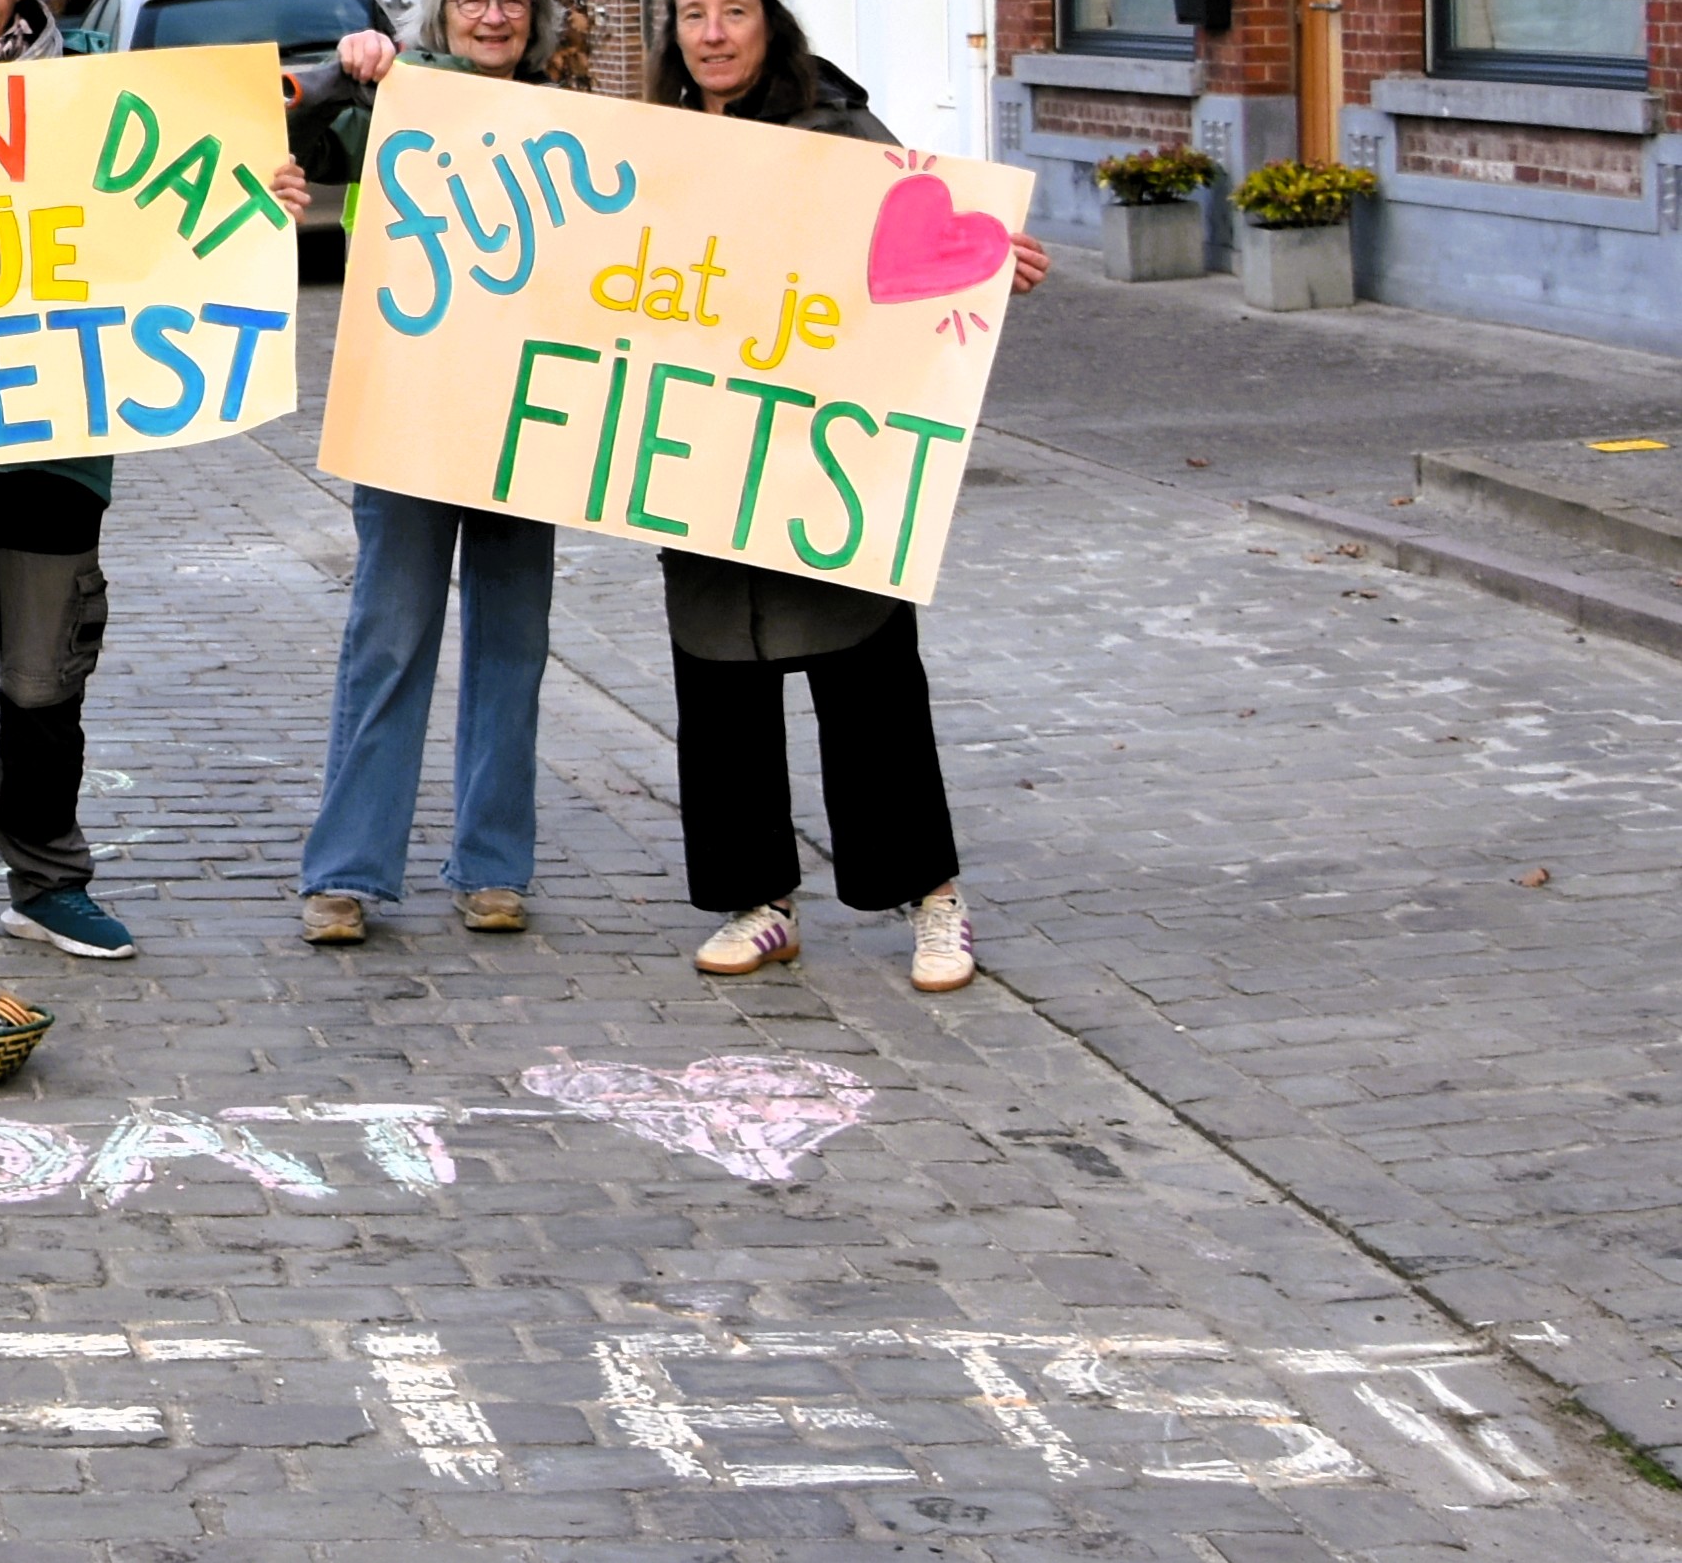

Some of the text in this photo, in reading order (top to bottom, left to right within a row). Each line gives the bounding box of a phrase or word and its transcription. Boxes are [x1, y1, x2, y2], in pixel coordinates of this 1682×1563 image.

[92, 89, 288, 259] DAT
[377, 129, 637, 336] fijn
[589, 226, 841, 371] dat je
[492, 337, 966, 586] FIETST
